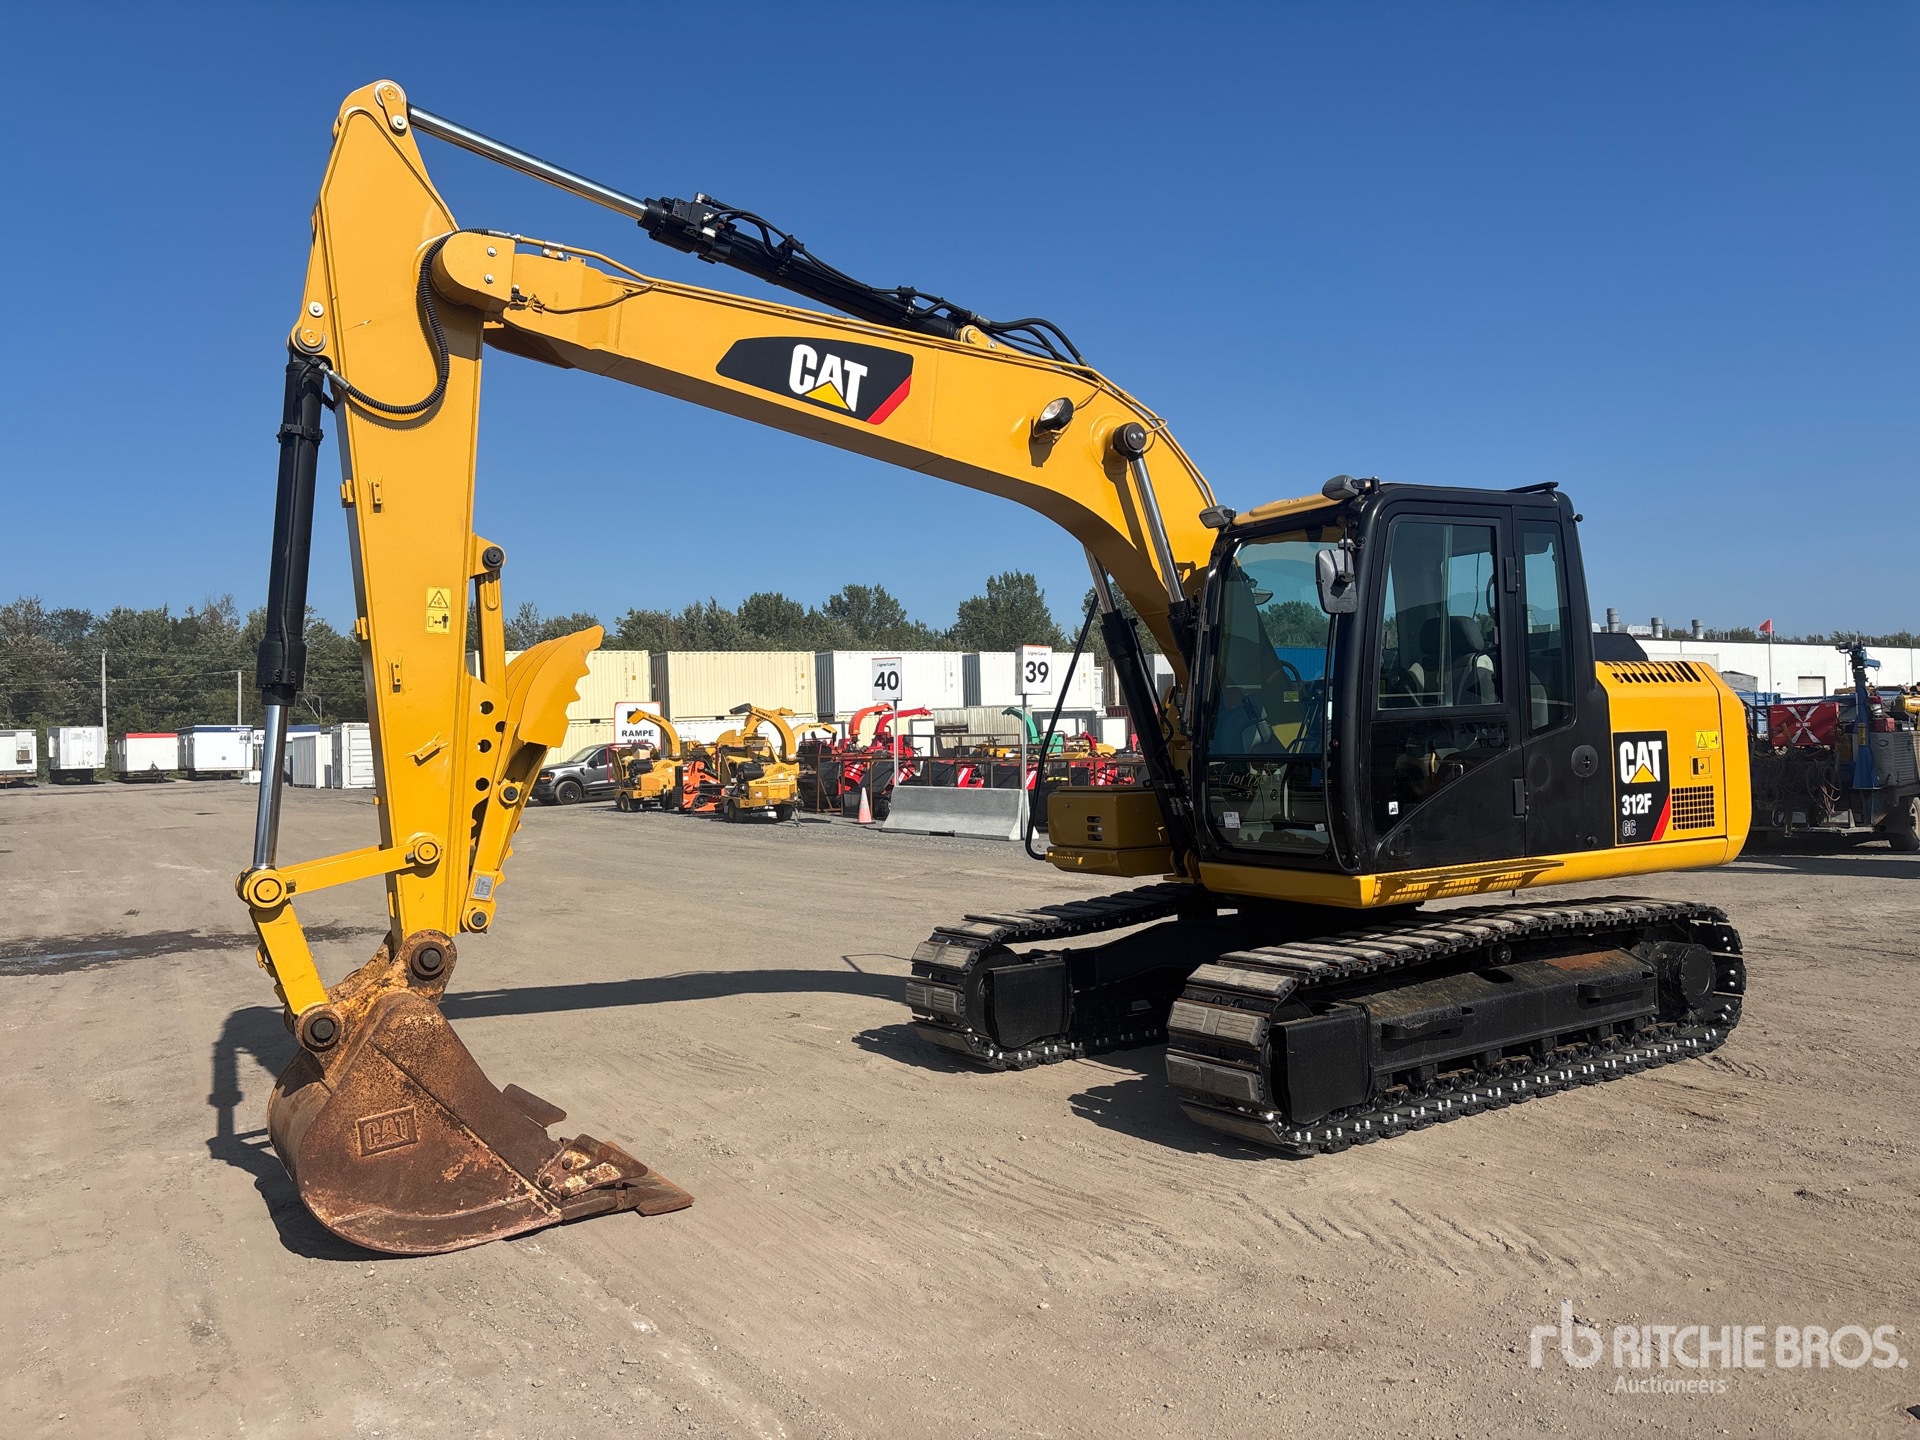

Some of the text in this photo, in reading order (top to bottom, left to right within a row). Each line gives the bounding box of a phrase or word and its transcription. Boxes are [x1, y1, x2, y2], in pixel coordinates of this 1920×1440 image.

[788, 343, 868, 412] CAT
[873, 670, 899, 690] 40
[1025, 661, 1049, 683] 39
[1619, 740, 1663, 785] CAT
[1621, 793, 1652, 816] 312F
[1622, 819, 1637, 837] GC
[363, 1113, 411, 1150] CAT
